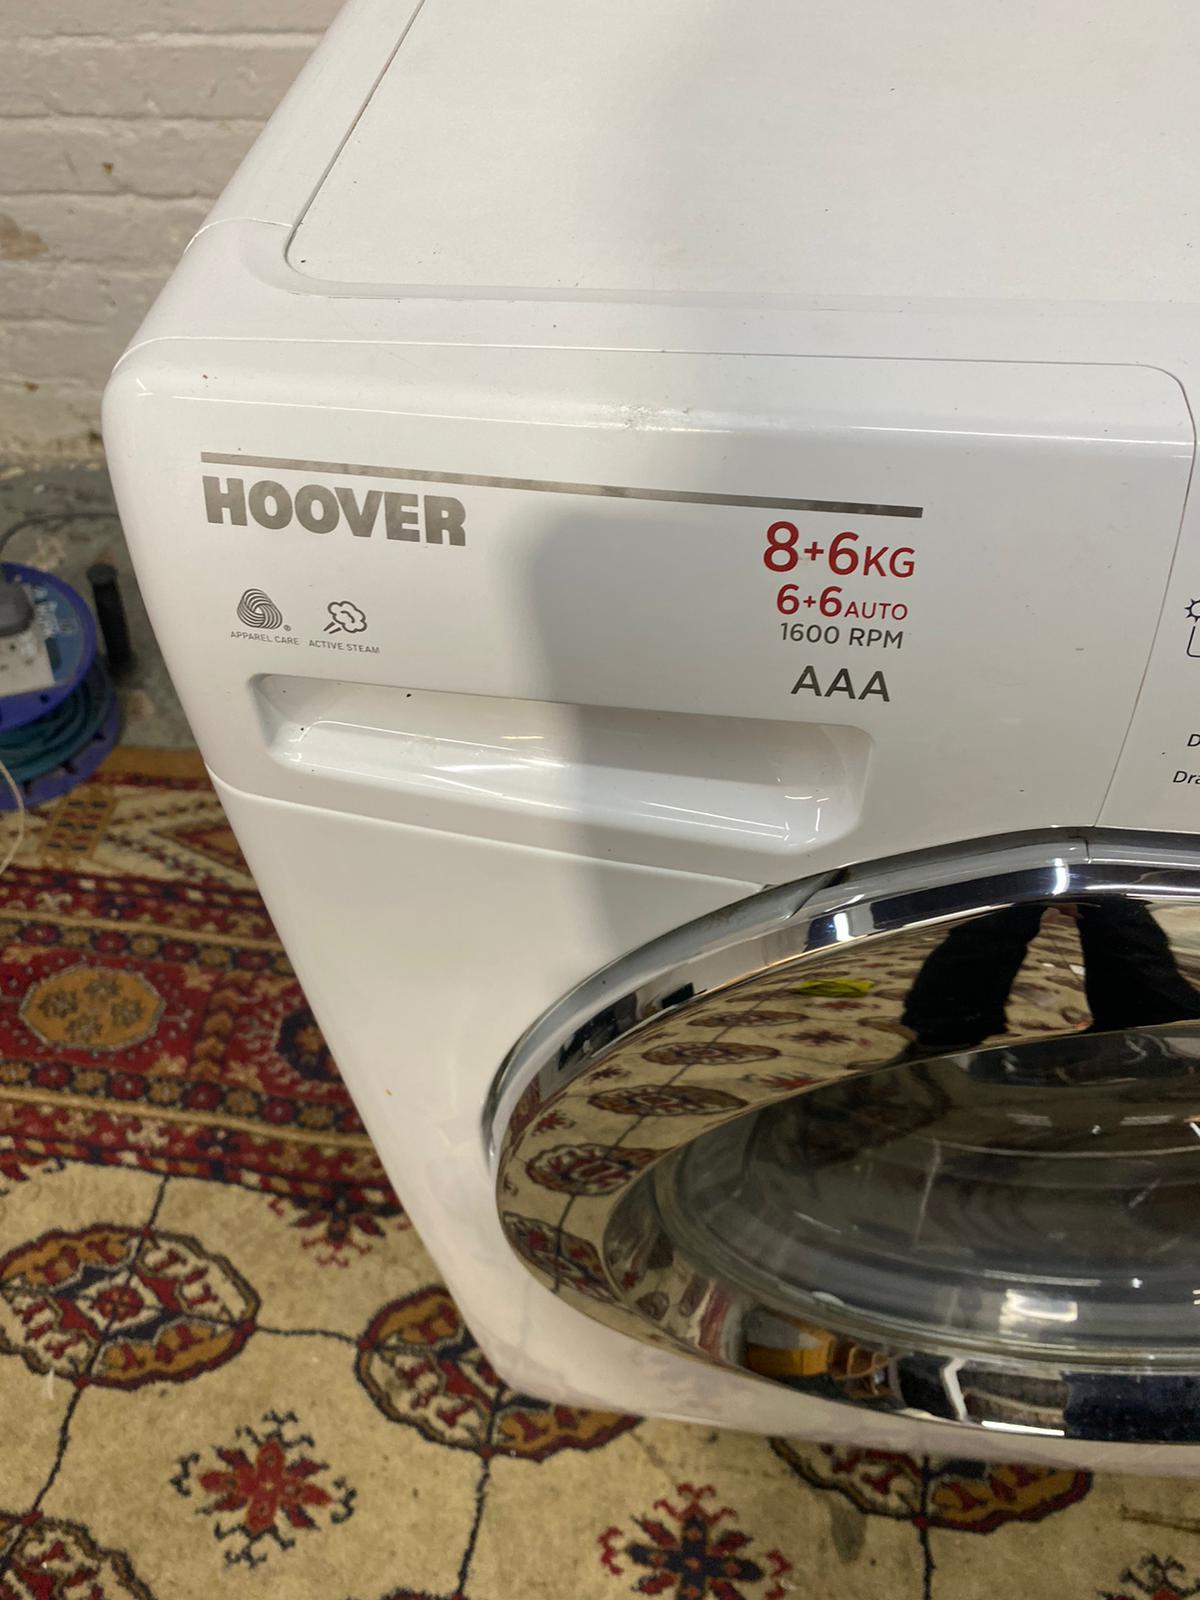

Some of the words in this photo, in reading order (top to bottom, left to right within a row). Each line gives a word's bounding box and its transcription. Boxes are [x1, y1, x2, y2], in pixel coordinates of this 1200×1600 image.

[202, 475, 466, 546] HOOVER
[230, 631, 272, 643] APPAREL
[274, 635, 299, 646] CARE
[308, 639, 344, 650] ACTIVE
[345, 643, 380, 654] STEAM
[780, 622, 840, 644] 1600
[849, 628, 903, 649] RPM
[790, 665, 890, 702] AAA
